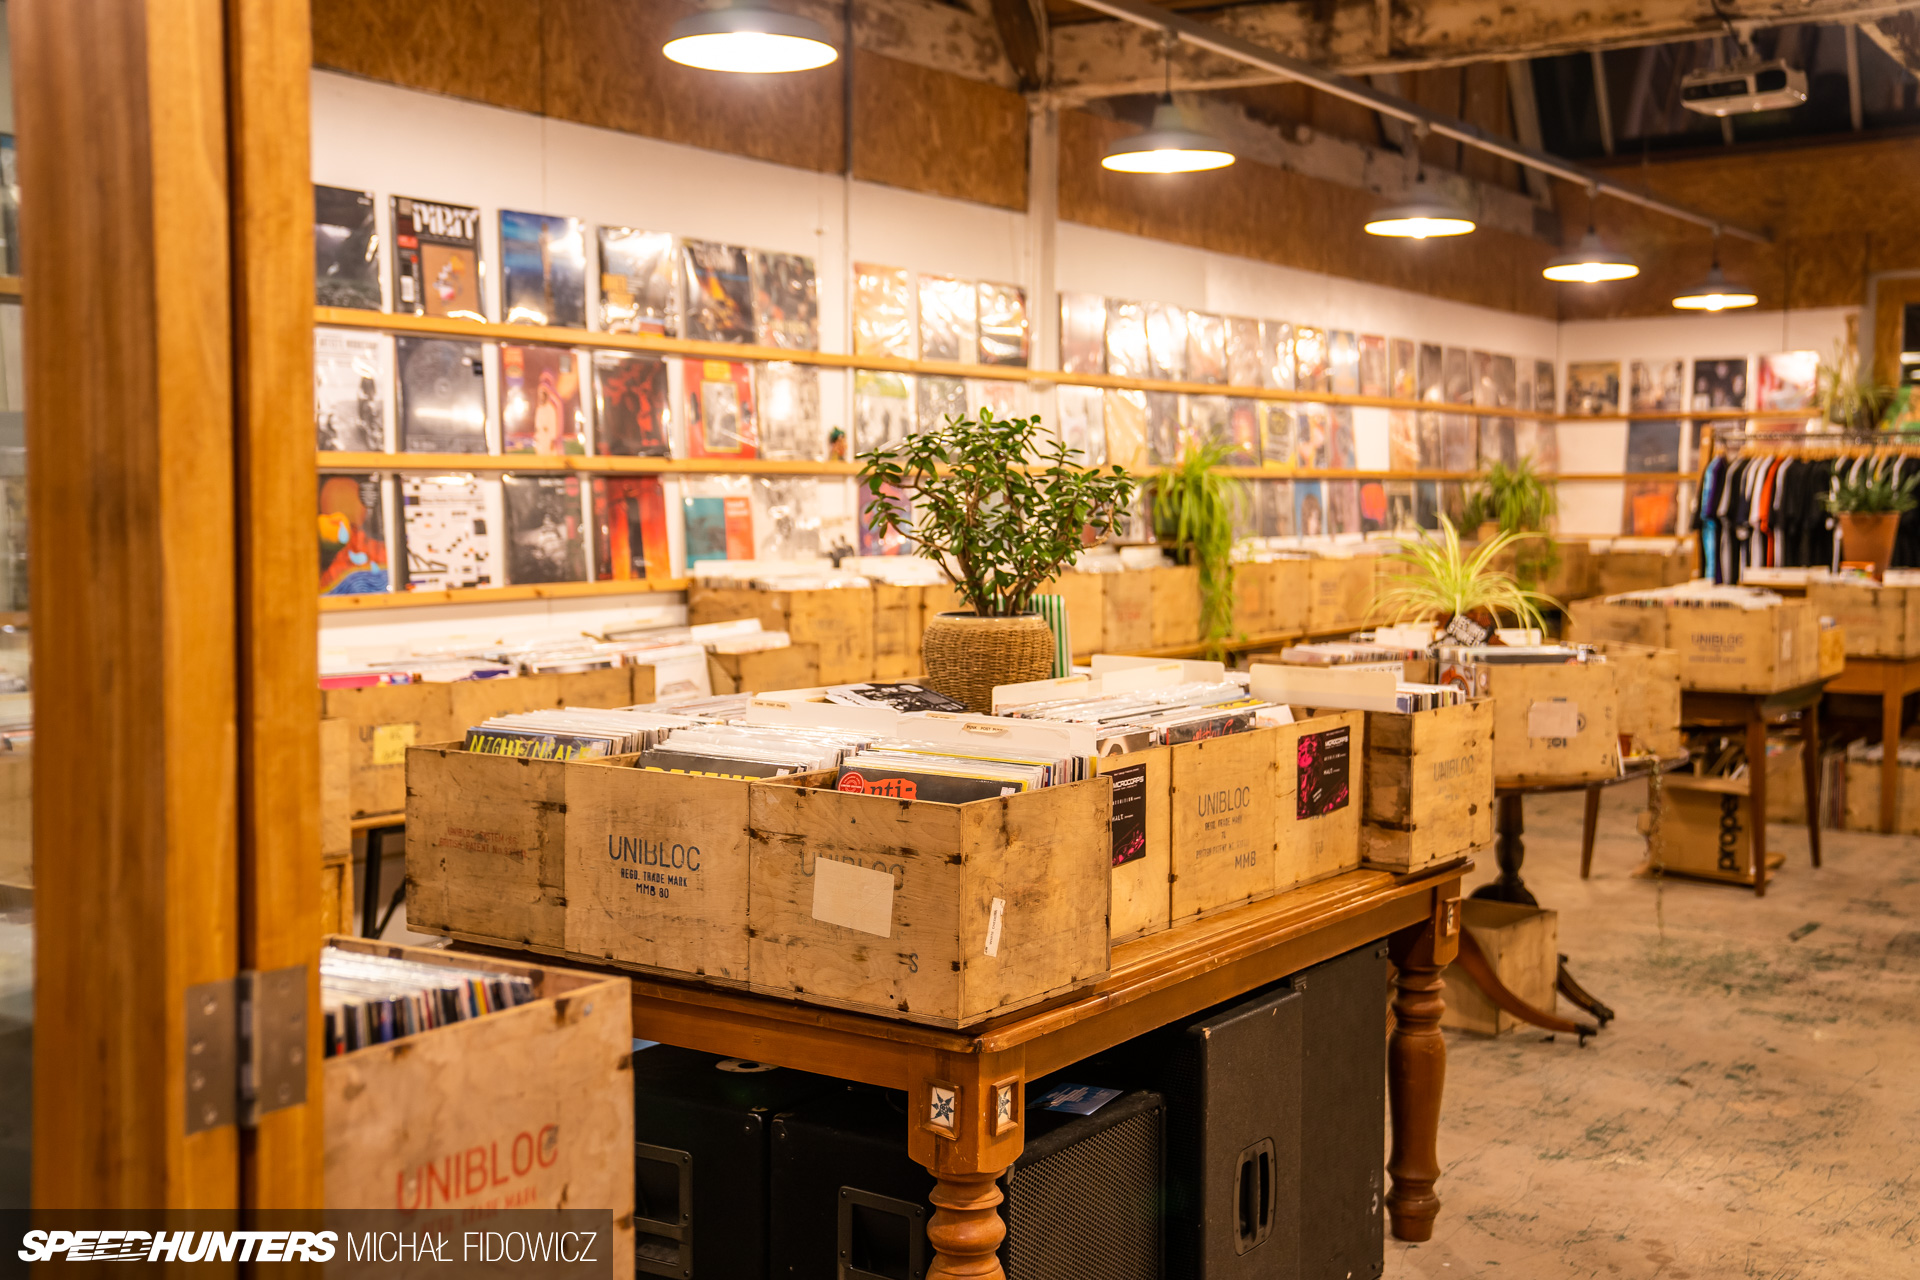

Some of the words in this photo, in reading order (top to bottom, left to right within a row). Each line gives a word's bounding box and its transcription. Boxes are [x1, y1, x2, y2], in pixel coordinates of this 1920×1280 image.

[863, 780, 912, 798] nti-
[1198, 786, 1250, 818] UNIBLOC
[465, 841, 489, 853] PATENT
[608, 834, 701, 871] UNIBLOC
[1234, 850, 1256, 869] MMB
[643, 871, 665, 883] TRADE
[667, 875, 688, 887] MARK
[635, 883, 656, 896] MMB
[396, 1123, 559, 1215] UNIBLOC
